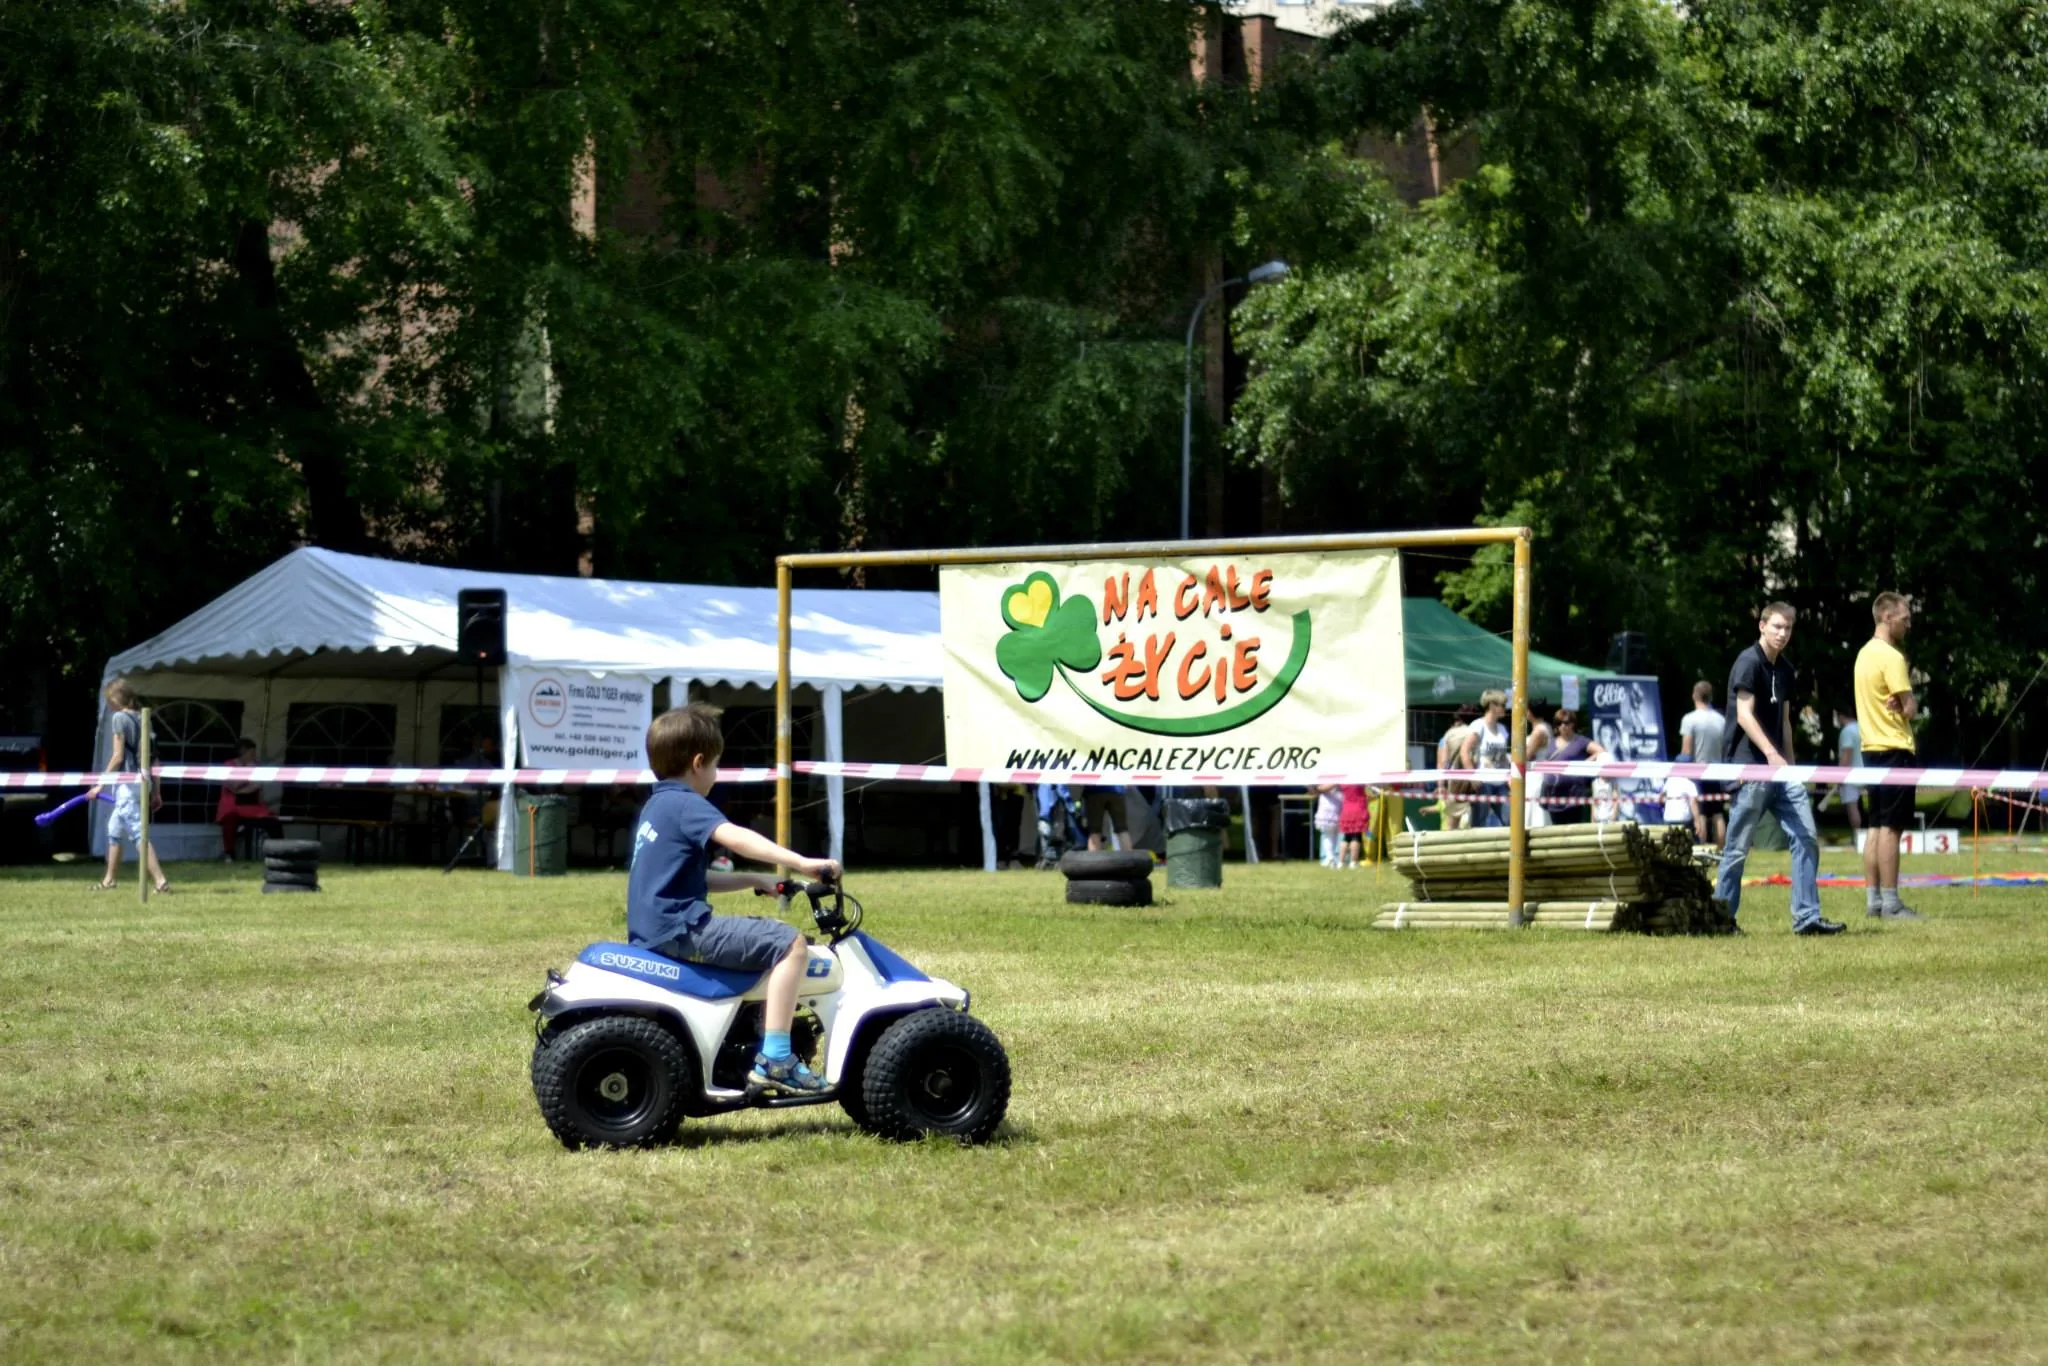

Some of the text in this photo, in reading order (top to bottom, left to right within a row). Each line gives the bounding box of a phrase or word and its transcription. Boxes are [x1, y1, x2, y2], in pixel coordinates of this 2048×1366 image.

[1103, 567, 1158, 625] NA
[1101, 623, 1261, 704] ŻYCIE
[530, 744, 638, 760] www.goldtiger.pl
[1004, 747, 1321, 774] WWW.NACALEZYCIE.ORG
[1901, 834, 1949, 854] 1 3
[600, 952, 680, 980] SUZUKI
